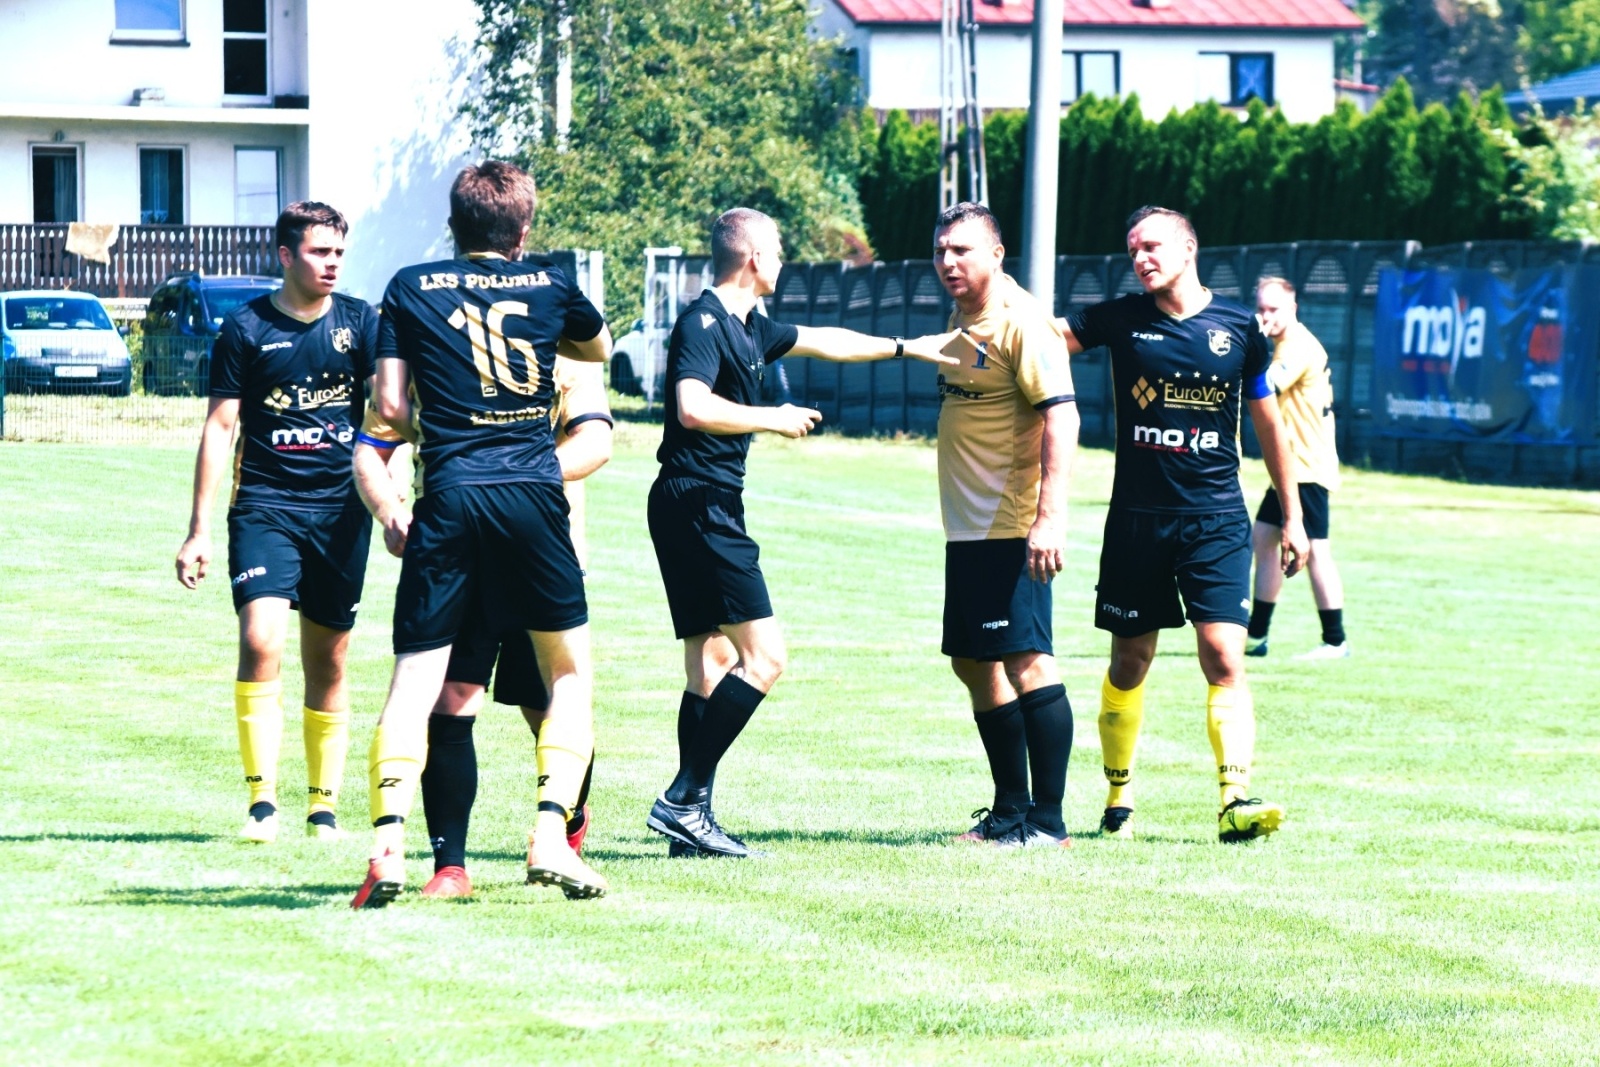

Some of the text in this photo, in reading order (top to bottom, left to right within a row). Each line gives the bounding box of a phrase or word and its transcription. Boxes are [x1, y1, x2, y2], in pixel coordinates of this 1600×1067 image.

[419, 271, 551, 290] LKS POLONIA
[447, 301, 541, 397] 16
[1164, 383, 1226, 404] EuroVip
